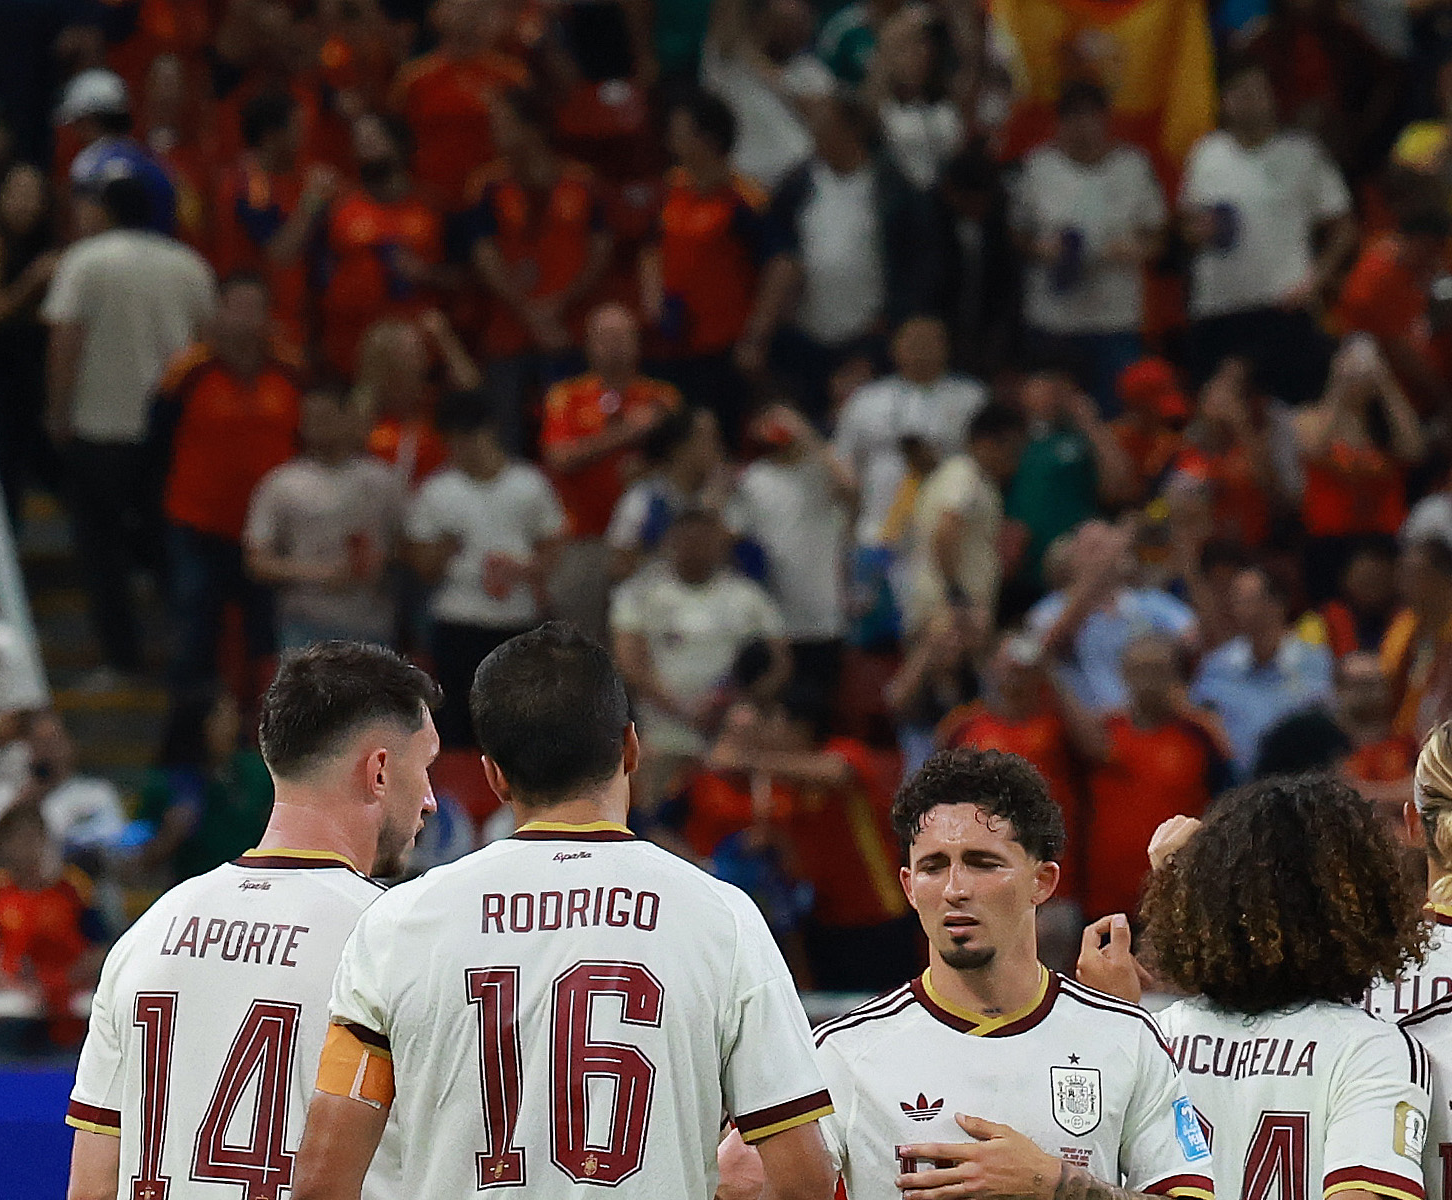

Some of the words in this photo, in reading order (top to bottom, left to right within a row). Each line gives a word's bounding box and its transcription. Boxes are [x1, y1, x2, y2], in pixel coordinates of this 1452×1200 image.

[481, 886, 661, 934] RODRIGO
[160, 916, 310, 968] LAPORTE
[464, 960, 665, 1191] 16
